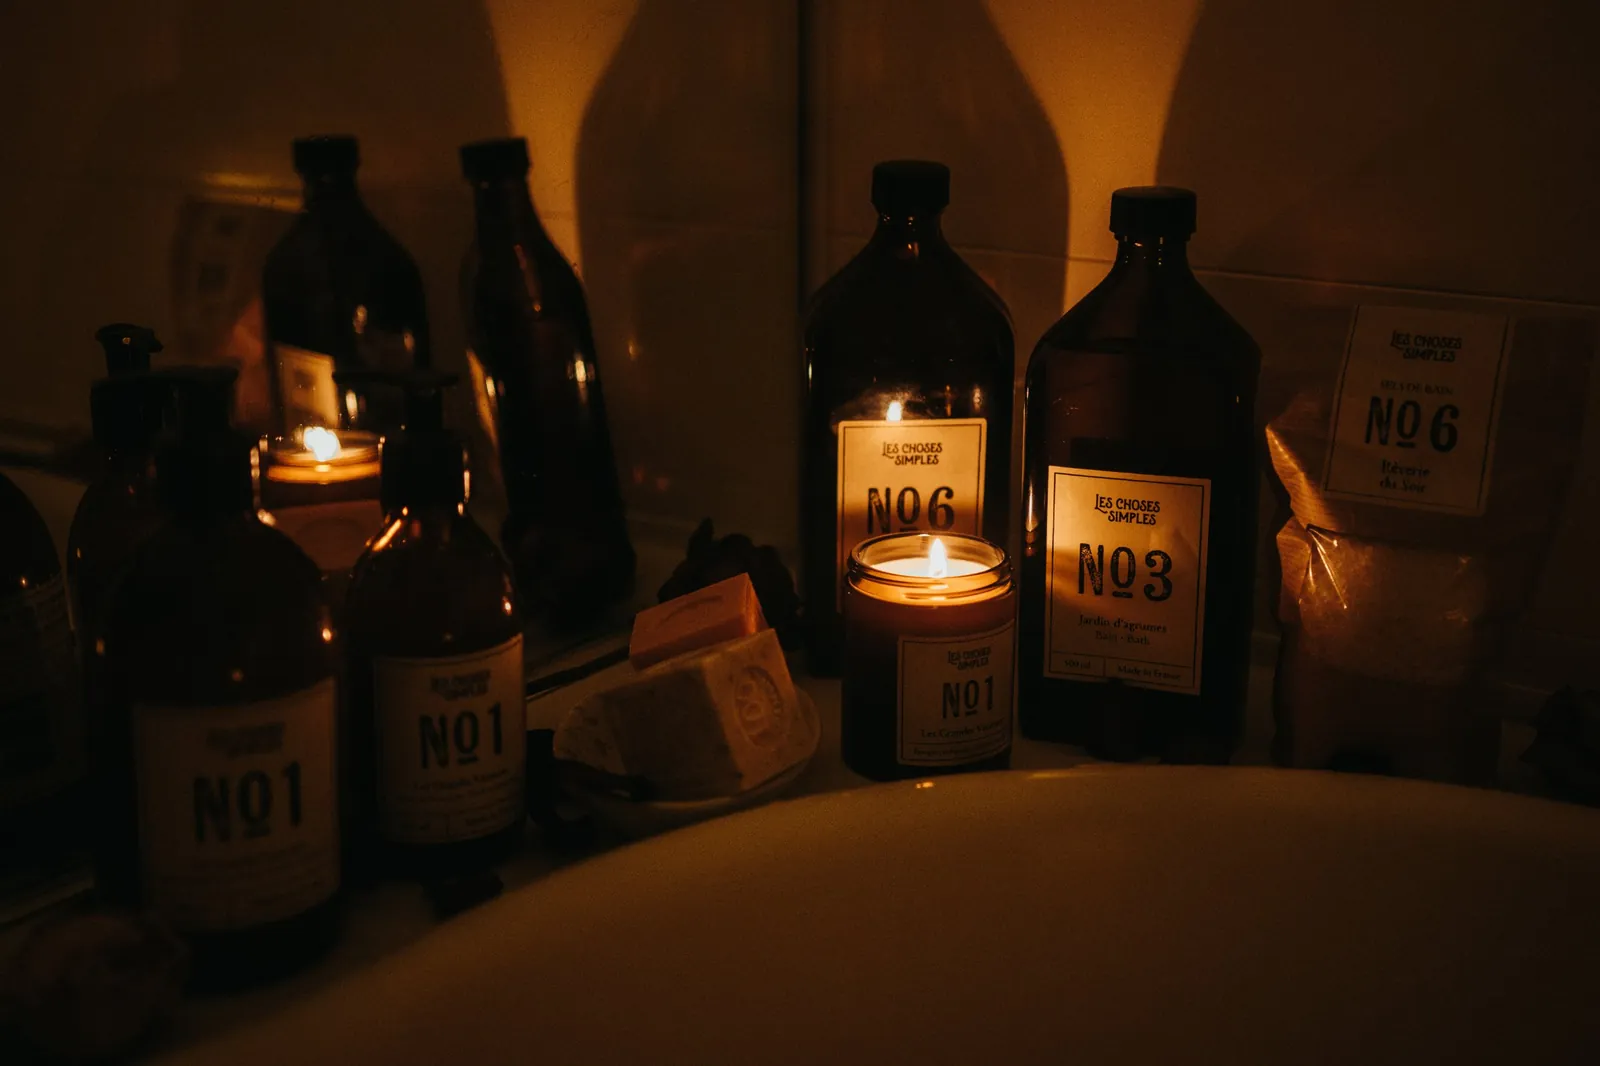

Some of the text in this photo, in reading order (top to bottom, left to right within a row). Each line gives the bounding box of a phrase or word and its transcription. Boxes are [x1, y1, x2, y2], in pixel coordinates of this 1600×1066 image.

[882, 442, 943, 459] LES CHOSES
[894, 454, 940, 466] SIMPLES
[1094, 493, 1160, 514] LES CHOSES
[1107, 510, 1157, 525] SIMPLES
[1078, 614, 1110, 629] Jardin
[1126, 633, 1150, 645] Bath
[1117, 664, 1141, 677] Made
